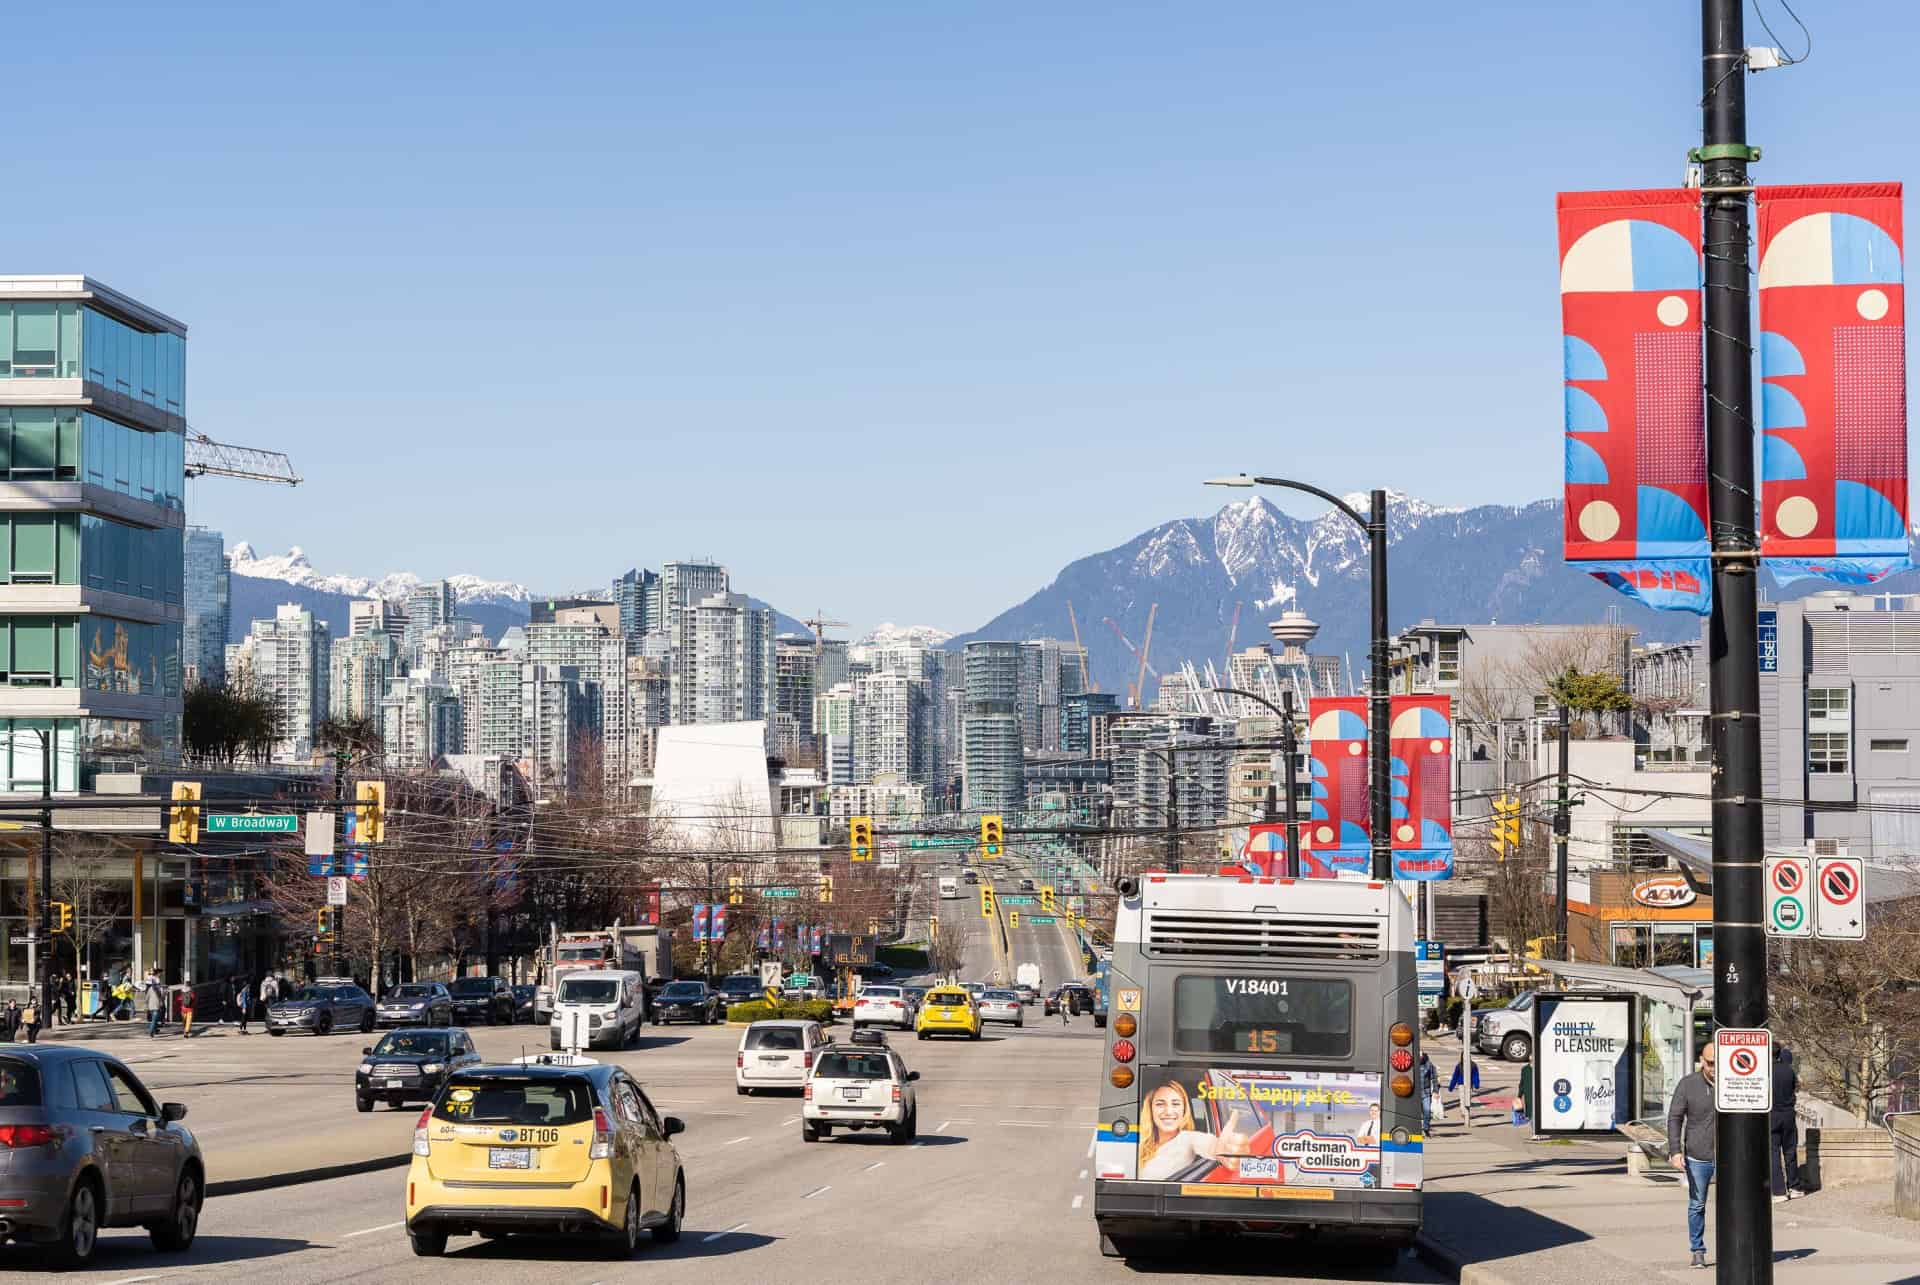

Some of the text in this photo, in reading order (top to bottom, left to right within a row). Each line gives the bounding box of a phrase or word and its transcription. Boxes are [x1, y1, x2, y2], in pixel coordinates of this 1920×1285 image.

[215, 817, 290, 830] W Broadway
[1646, 888, 1689, 901] A&W
[1728, 963, 1736, 973] 6
[1726, 973, 1739, 983] 25
[1226, 979, 1289, 996] V18401
[1554, 1021, 1594, 1036] GUILTY
[1247, 1029, 1278, 1053] 15
[1554, 1038, 1615, 1053] PLEASURE
[1720, 1033, 1767, 1045] TEMPORARY
[1198, 1081, 1247, 1100] Sara's
[1250, 1082, 1301, 1106] happy
[519, 1128, 559, 1143] BT106
[1281, 1140, 1347, 1153] craftsman
[1306, 1154, 1360, 1168] collision
